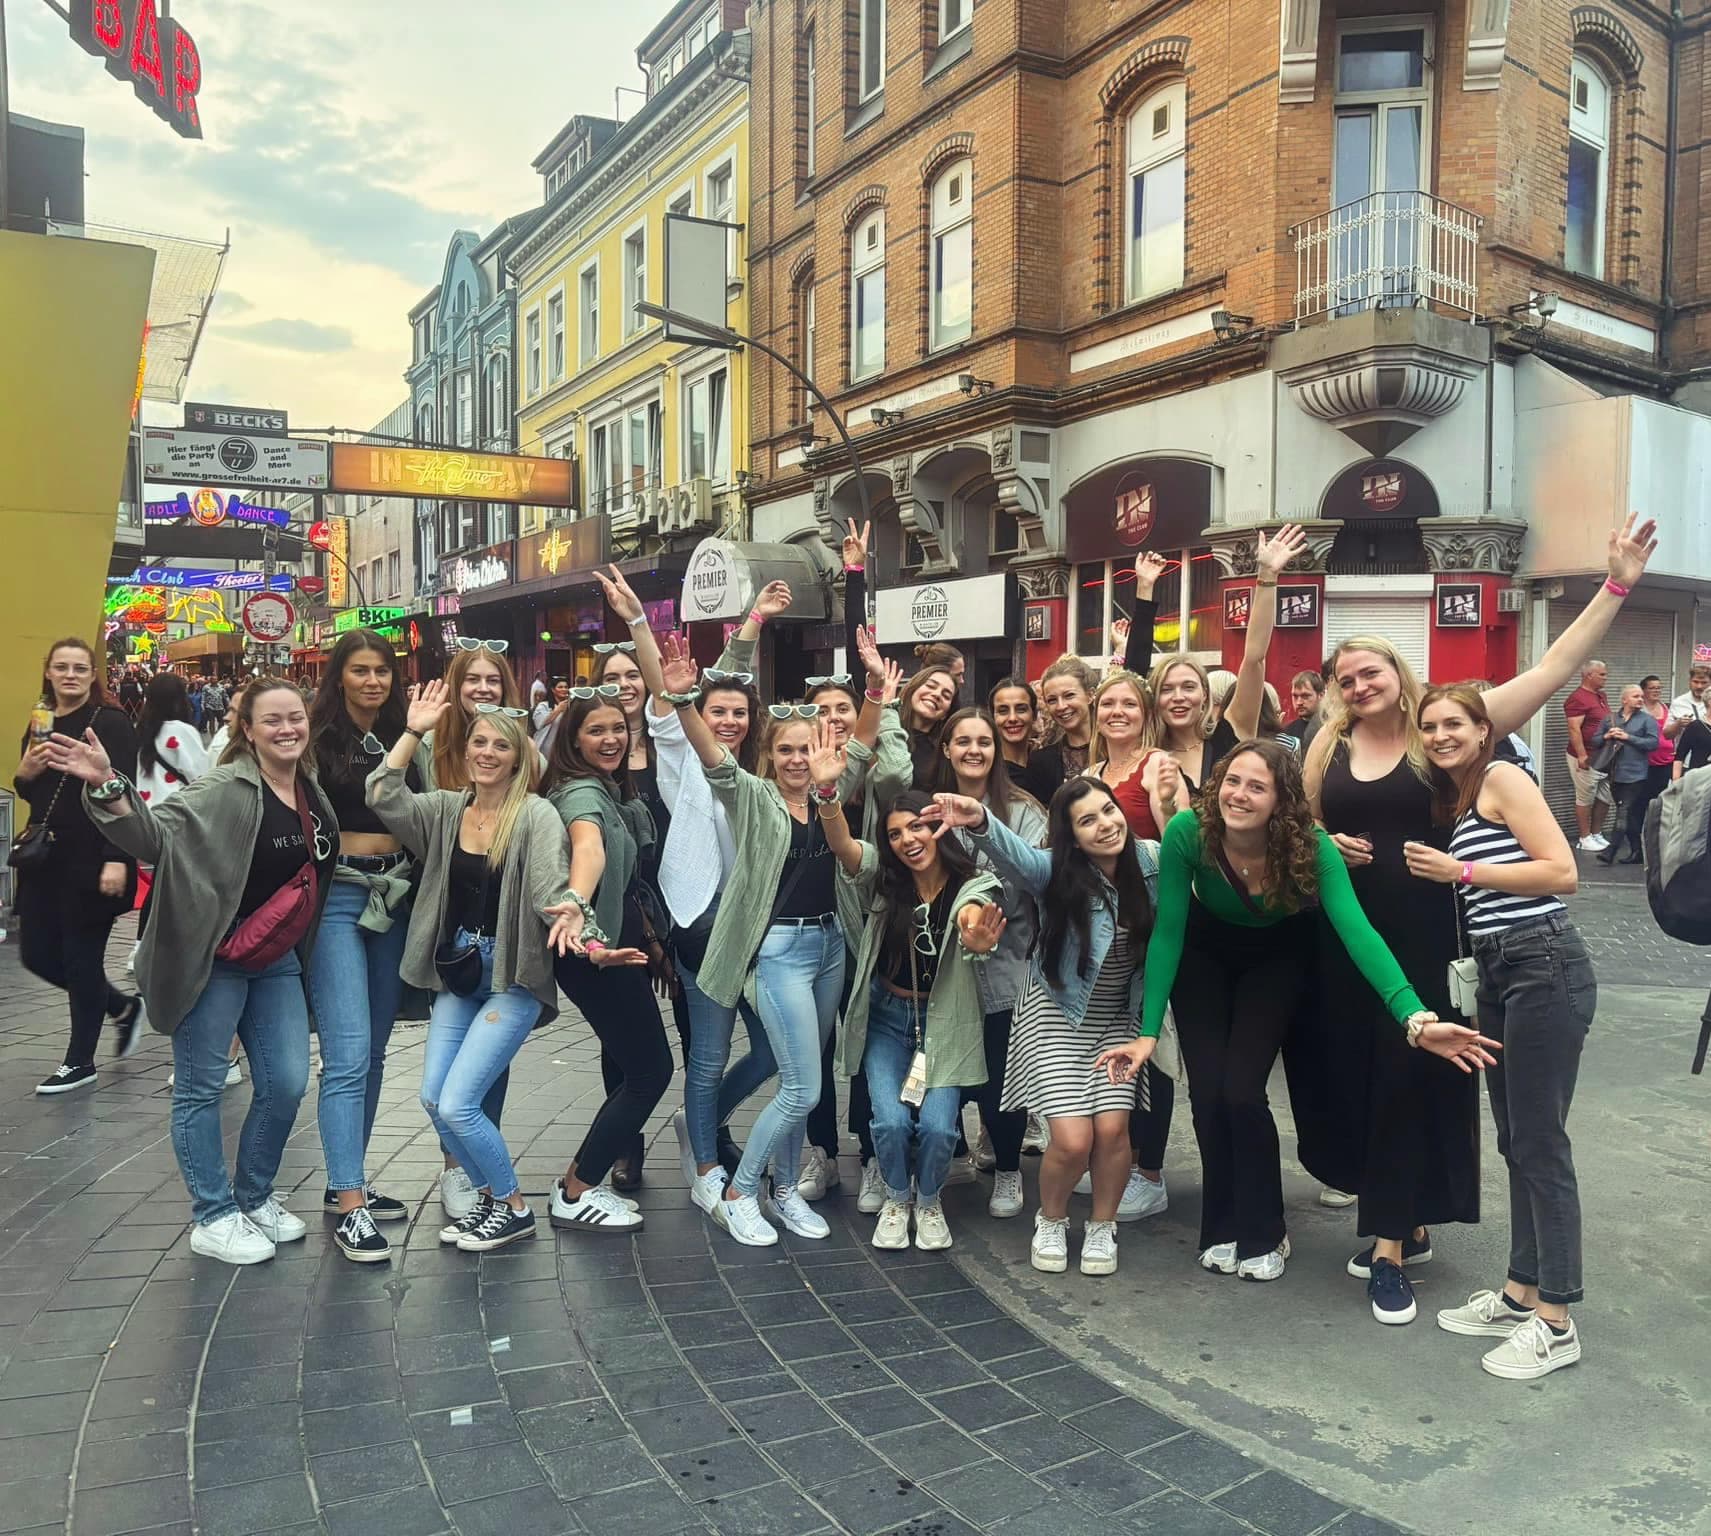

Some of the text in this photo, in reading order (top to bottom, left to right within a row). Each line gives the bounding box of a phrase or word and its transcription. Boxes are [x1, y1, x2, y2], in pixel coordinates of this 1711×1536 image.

[214, 412, 284, 430] BECK'S
[167, 443, 216, 454] Hier fängt
[263, 446, 291, 454] Dance
[171, 452, 215, 461] die Party
[268, 461, 292, 469] More
[237, 505, 275, 521] DANCE
[1115, 484, 1152, 531] IN
[146, 570, 185, 585] Club
[692, 570, 727, 591] PREMIER
[911, 603, 948, 620] PREMIER
[272, 836, 289, 849] WE
